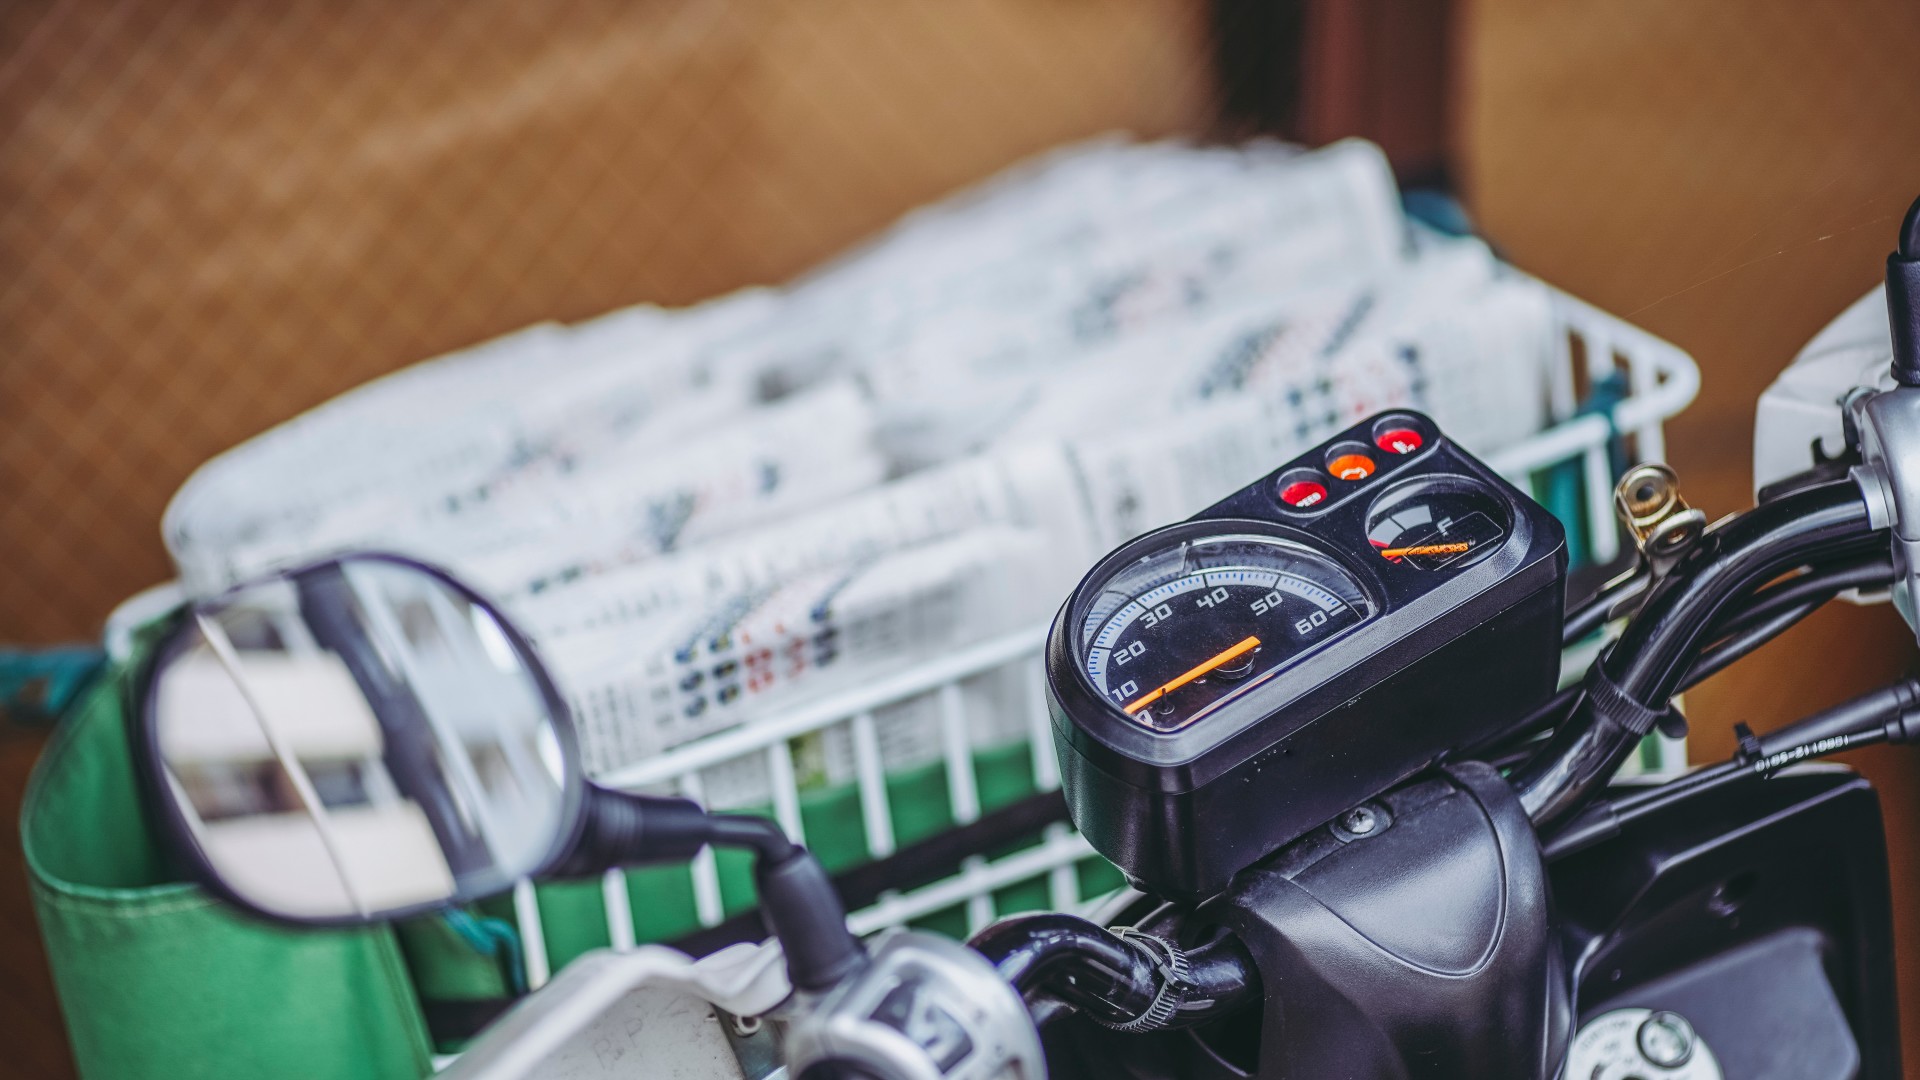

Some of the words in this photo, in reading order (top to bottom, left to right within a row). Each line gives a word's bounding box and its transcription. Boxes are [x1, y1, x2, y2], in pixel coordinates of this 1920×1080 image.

[1437, 516, 1454, 537] F
[1196, 586, 1230, 610] 40
[1250, 590, 1284, 617] 50
[1139, 603, 1173, 630] 30
[1295, 609, 1328, 636] 60
[1112, 640, 1146, 666] 20
[1111, 679, 1139, 702] 10
